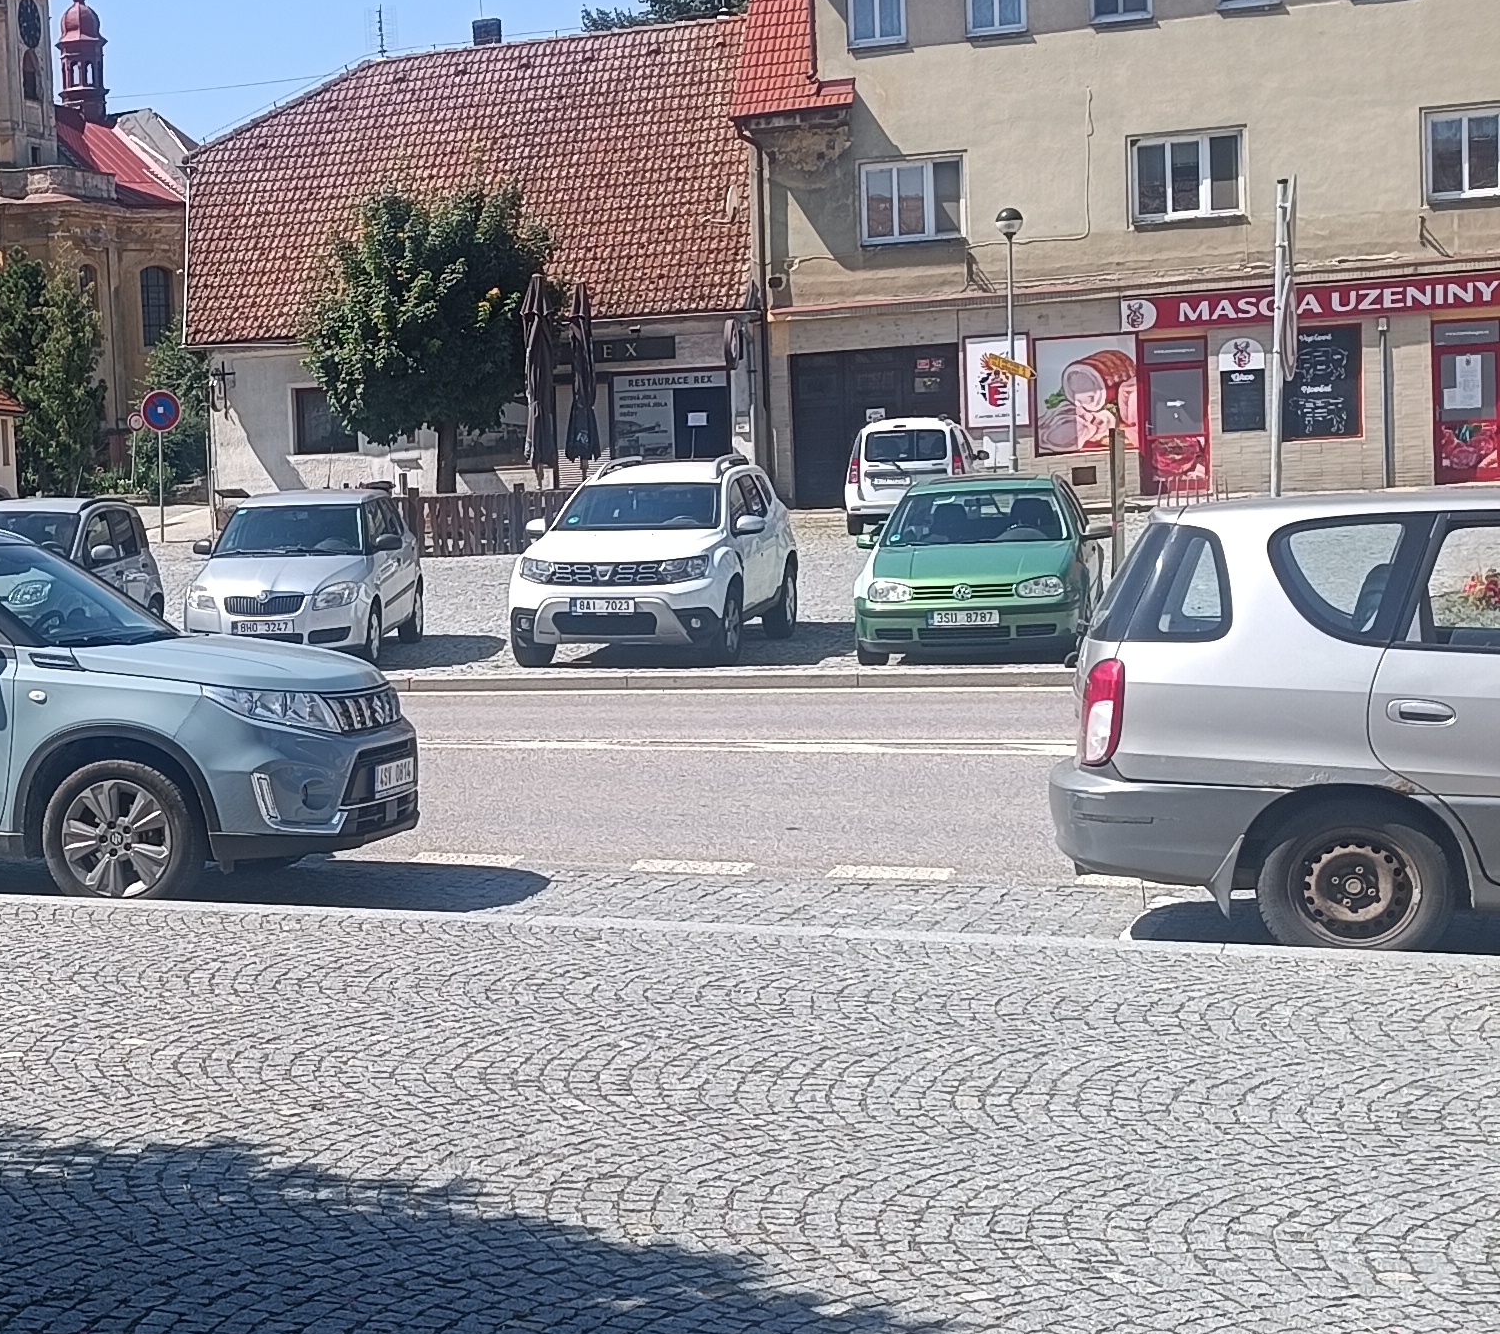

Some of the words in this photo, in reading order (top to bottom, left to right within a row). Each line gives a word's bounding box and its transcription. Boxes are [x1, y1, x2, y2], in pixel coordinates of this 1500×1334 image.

[1296, 293, 1323, 315] A
[1331, 280, 1500, 312] UZENINY
[602, 343, 638, 359] EX
[628, 376, 690, 387] RESTAURACE
[693, 374, 713, 385] REX
[604, 600, 630, 611] 7023
[936, 612, 957, 624] 3SU
[965, 611, 993, 624] 8787
[264, 621, 288, 633] 3247
